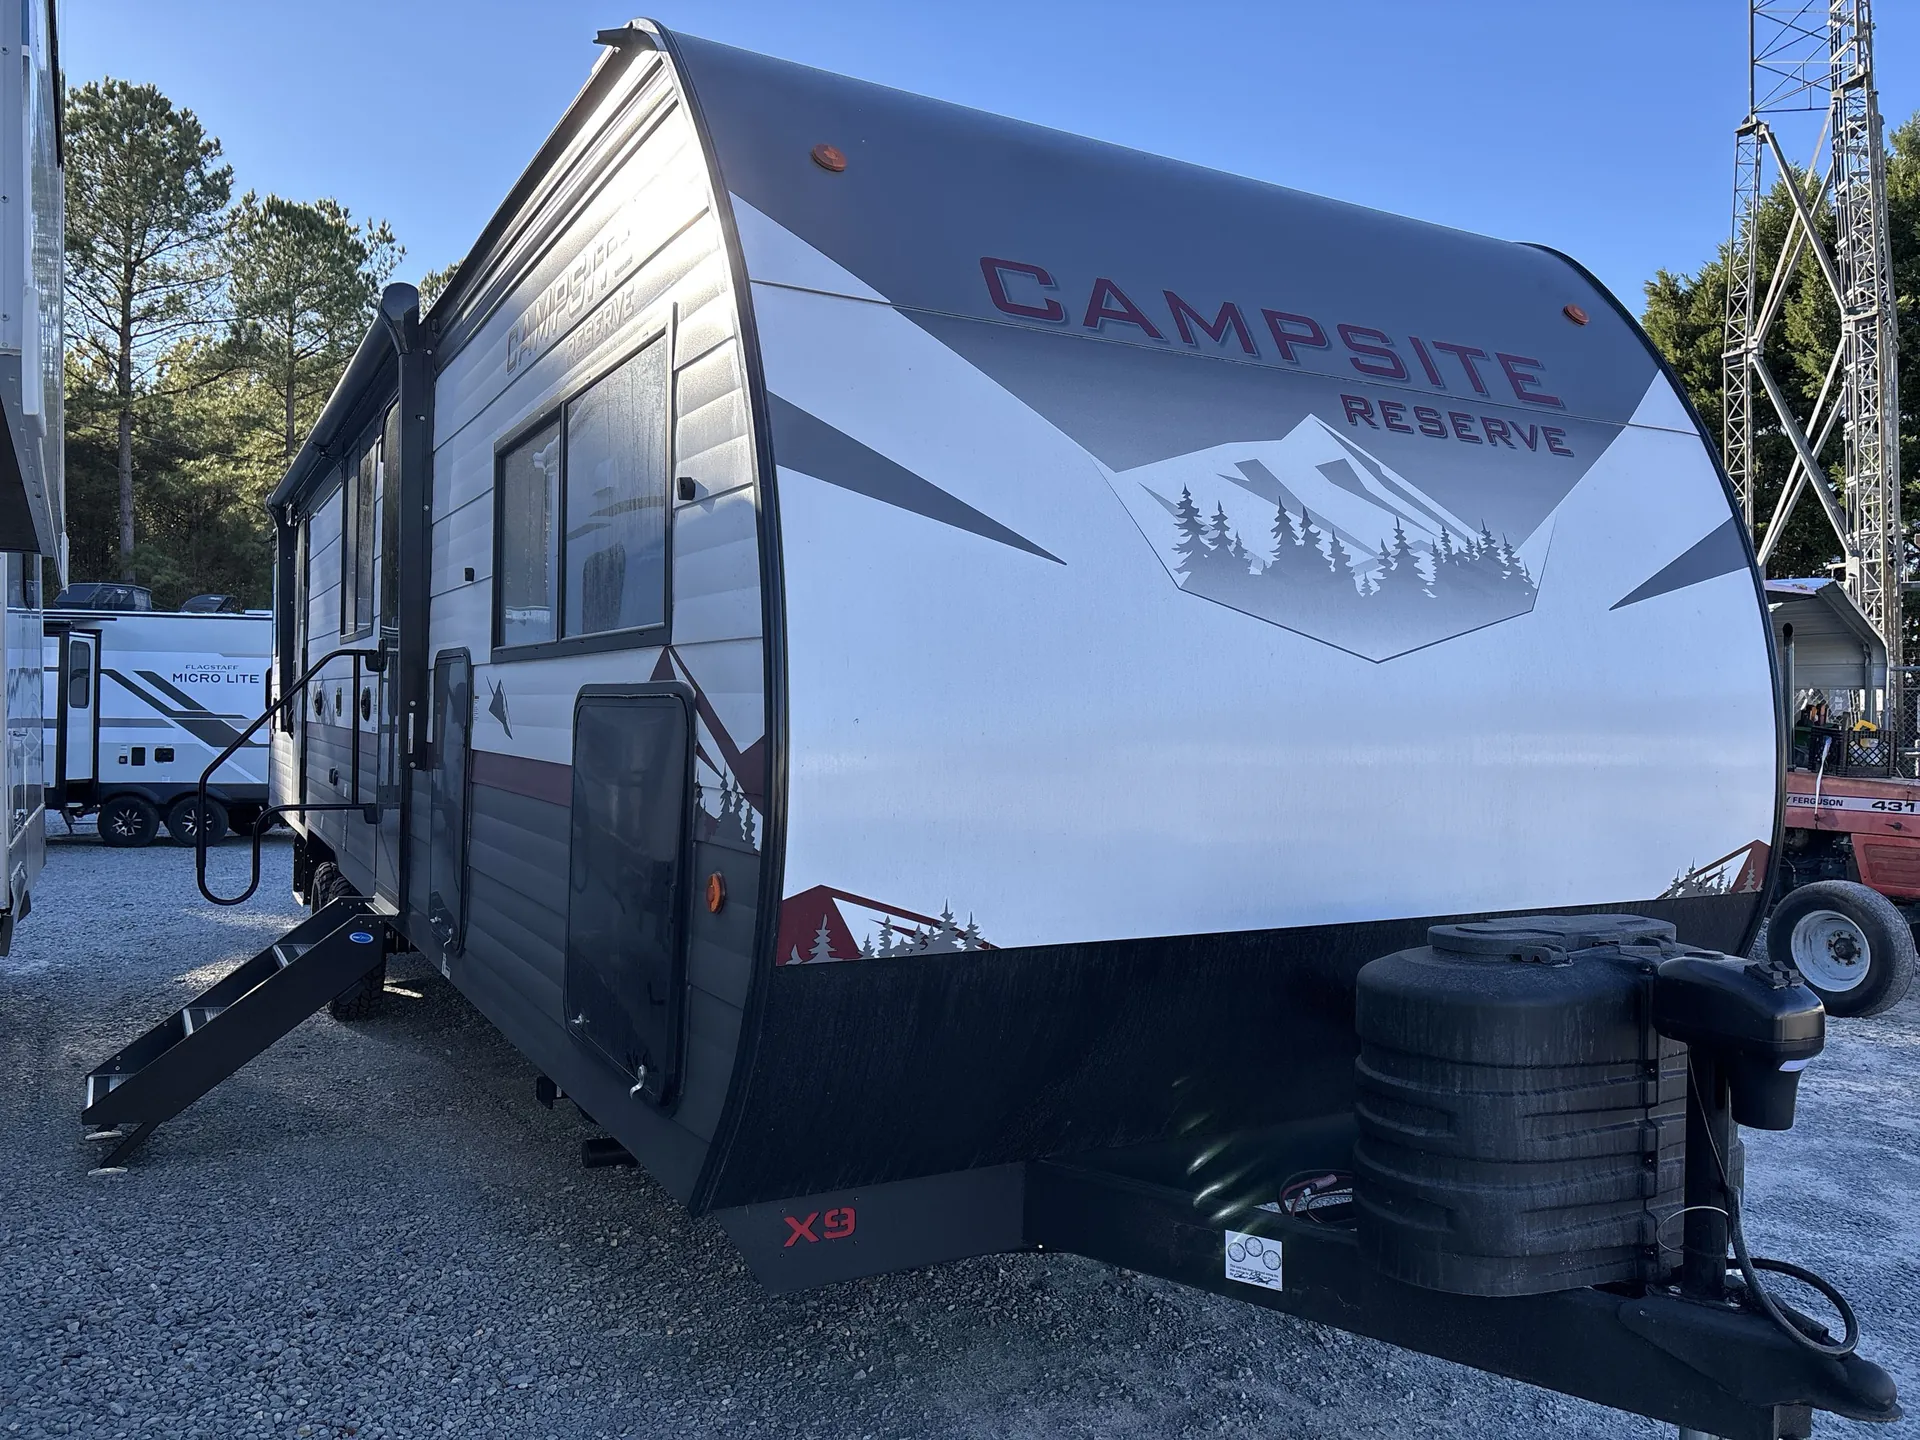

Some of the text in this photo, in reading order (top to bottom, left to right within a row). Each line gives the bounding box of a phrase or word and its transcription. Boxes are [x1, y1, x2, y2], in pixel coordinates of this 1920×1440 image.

[566, 284, 636, 368] RESERVE
[979, 256, 1565, 408] CAMPSITE
[1339, 394, 1575, 457] RESERVE
[172, 673, 260, 684] MICRO LITE
[1871, 800, 1916, 813] 431
[783, 1207, 856, 1248] X9
